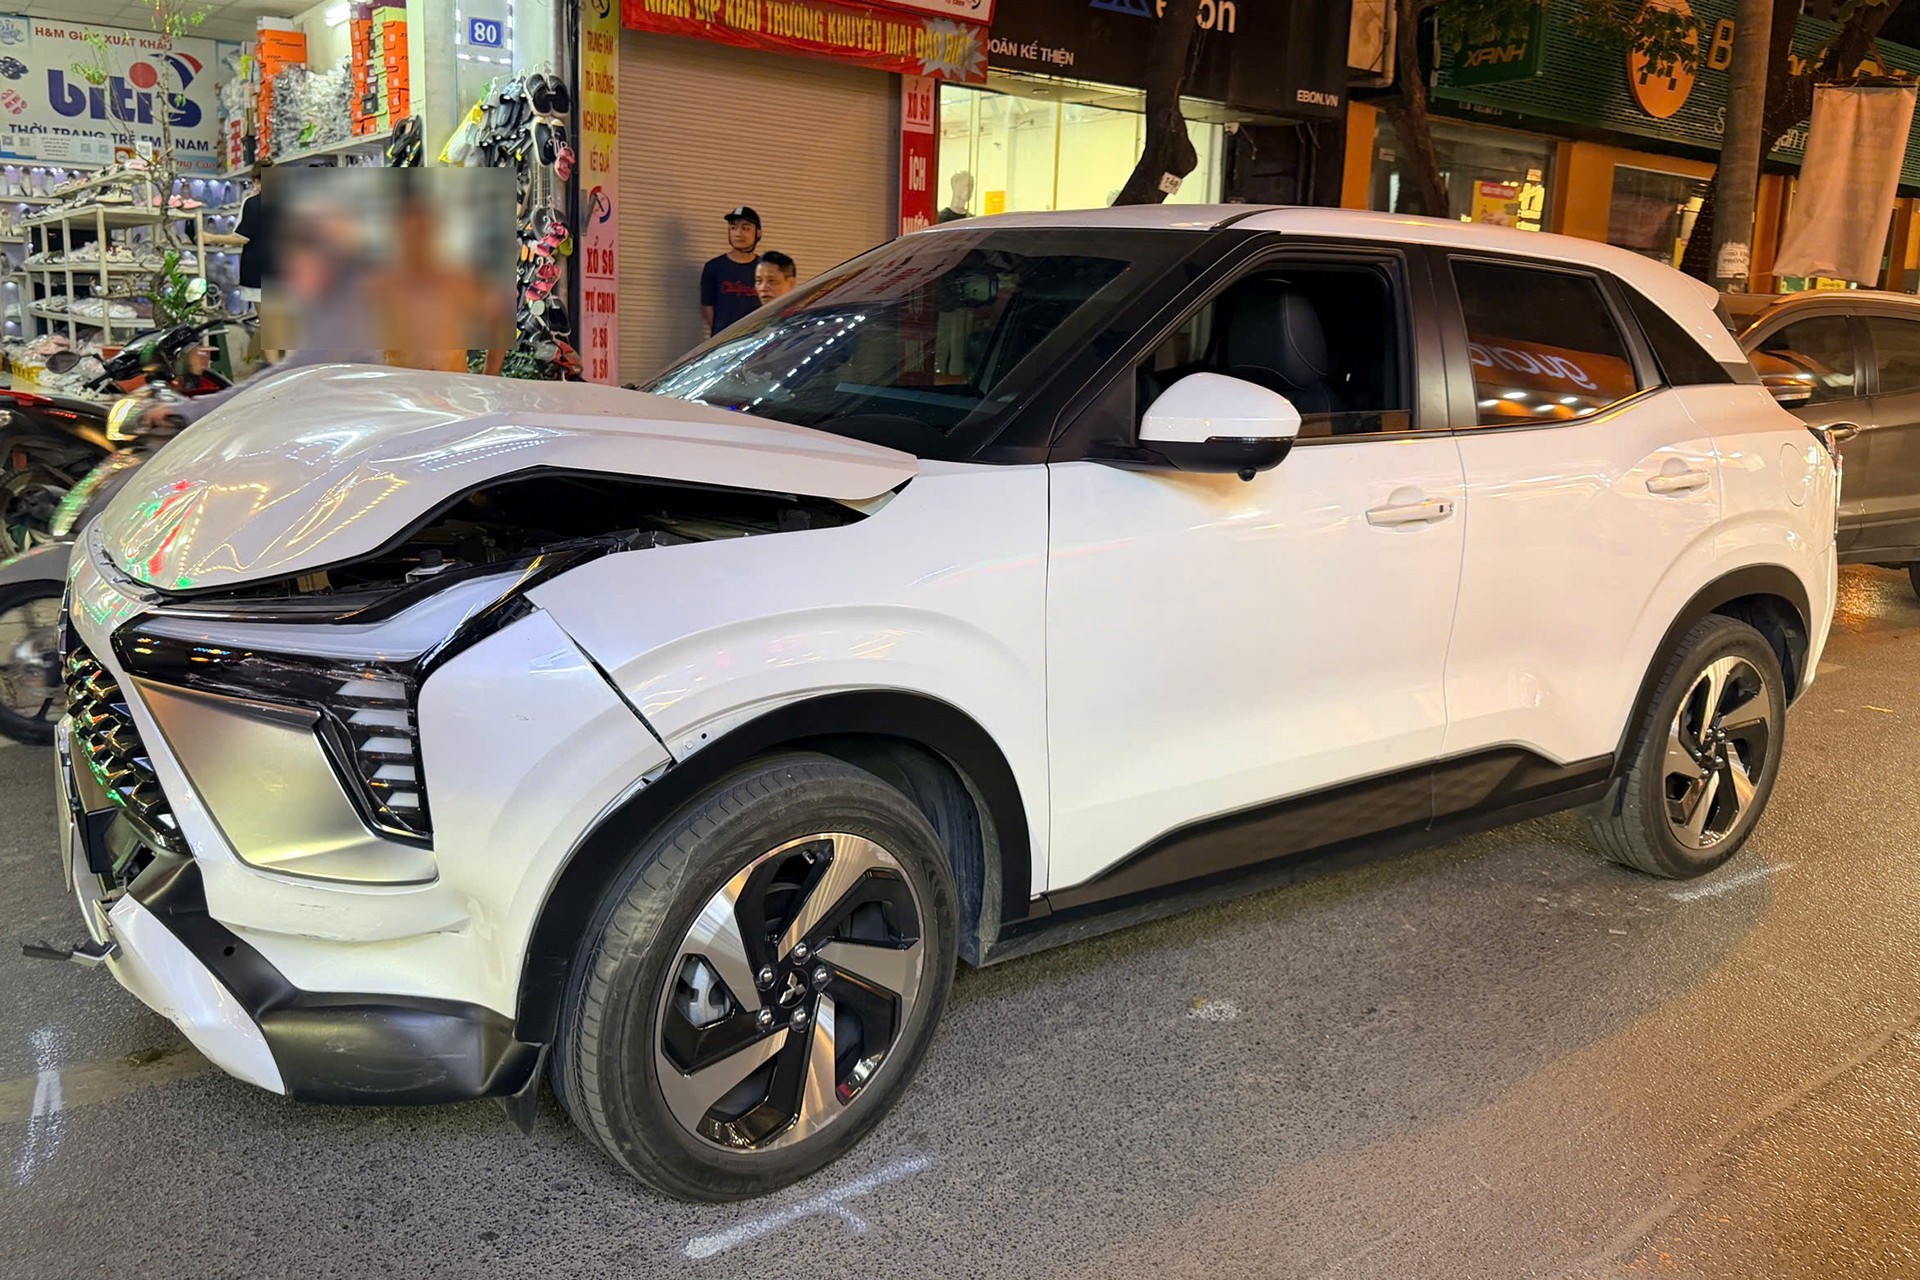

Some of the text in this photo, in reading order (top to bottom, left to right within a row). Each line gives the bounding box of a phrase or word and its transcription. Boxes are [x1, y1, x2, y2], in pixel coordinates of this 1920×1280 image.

[35, 26, 65, 39] H&M
[474, 22, 497, 43] 80
[725, 0, 761, 31] KHAI
[766, 2, 824, 42] TRƯỜNG
[828, 9, 882, 52] KHUYẾN
[886, 22, 913, 63] MẠI
[986, 38, 1075, 67] OÃN KẾ THIỆN
[1463, 42, 1527, 67] XANH
[920, 84, 931, 122] SỐ
[175, 138, 209, 151] NAM
[908, 148, 926, 191] ÍCH
[586, 236, 614, 275] XỔ SỐ
[585, 286, 596, 318] TỰ
[592, 321, 609, 349] 2 SỐ
[592, 350, 609, 380] 3 SỐ
